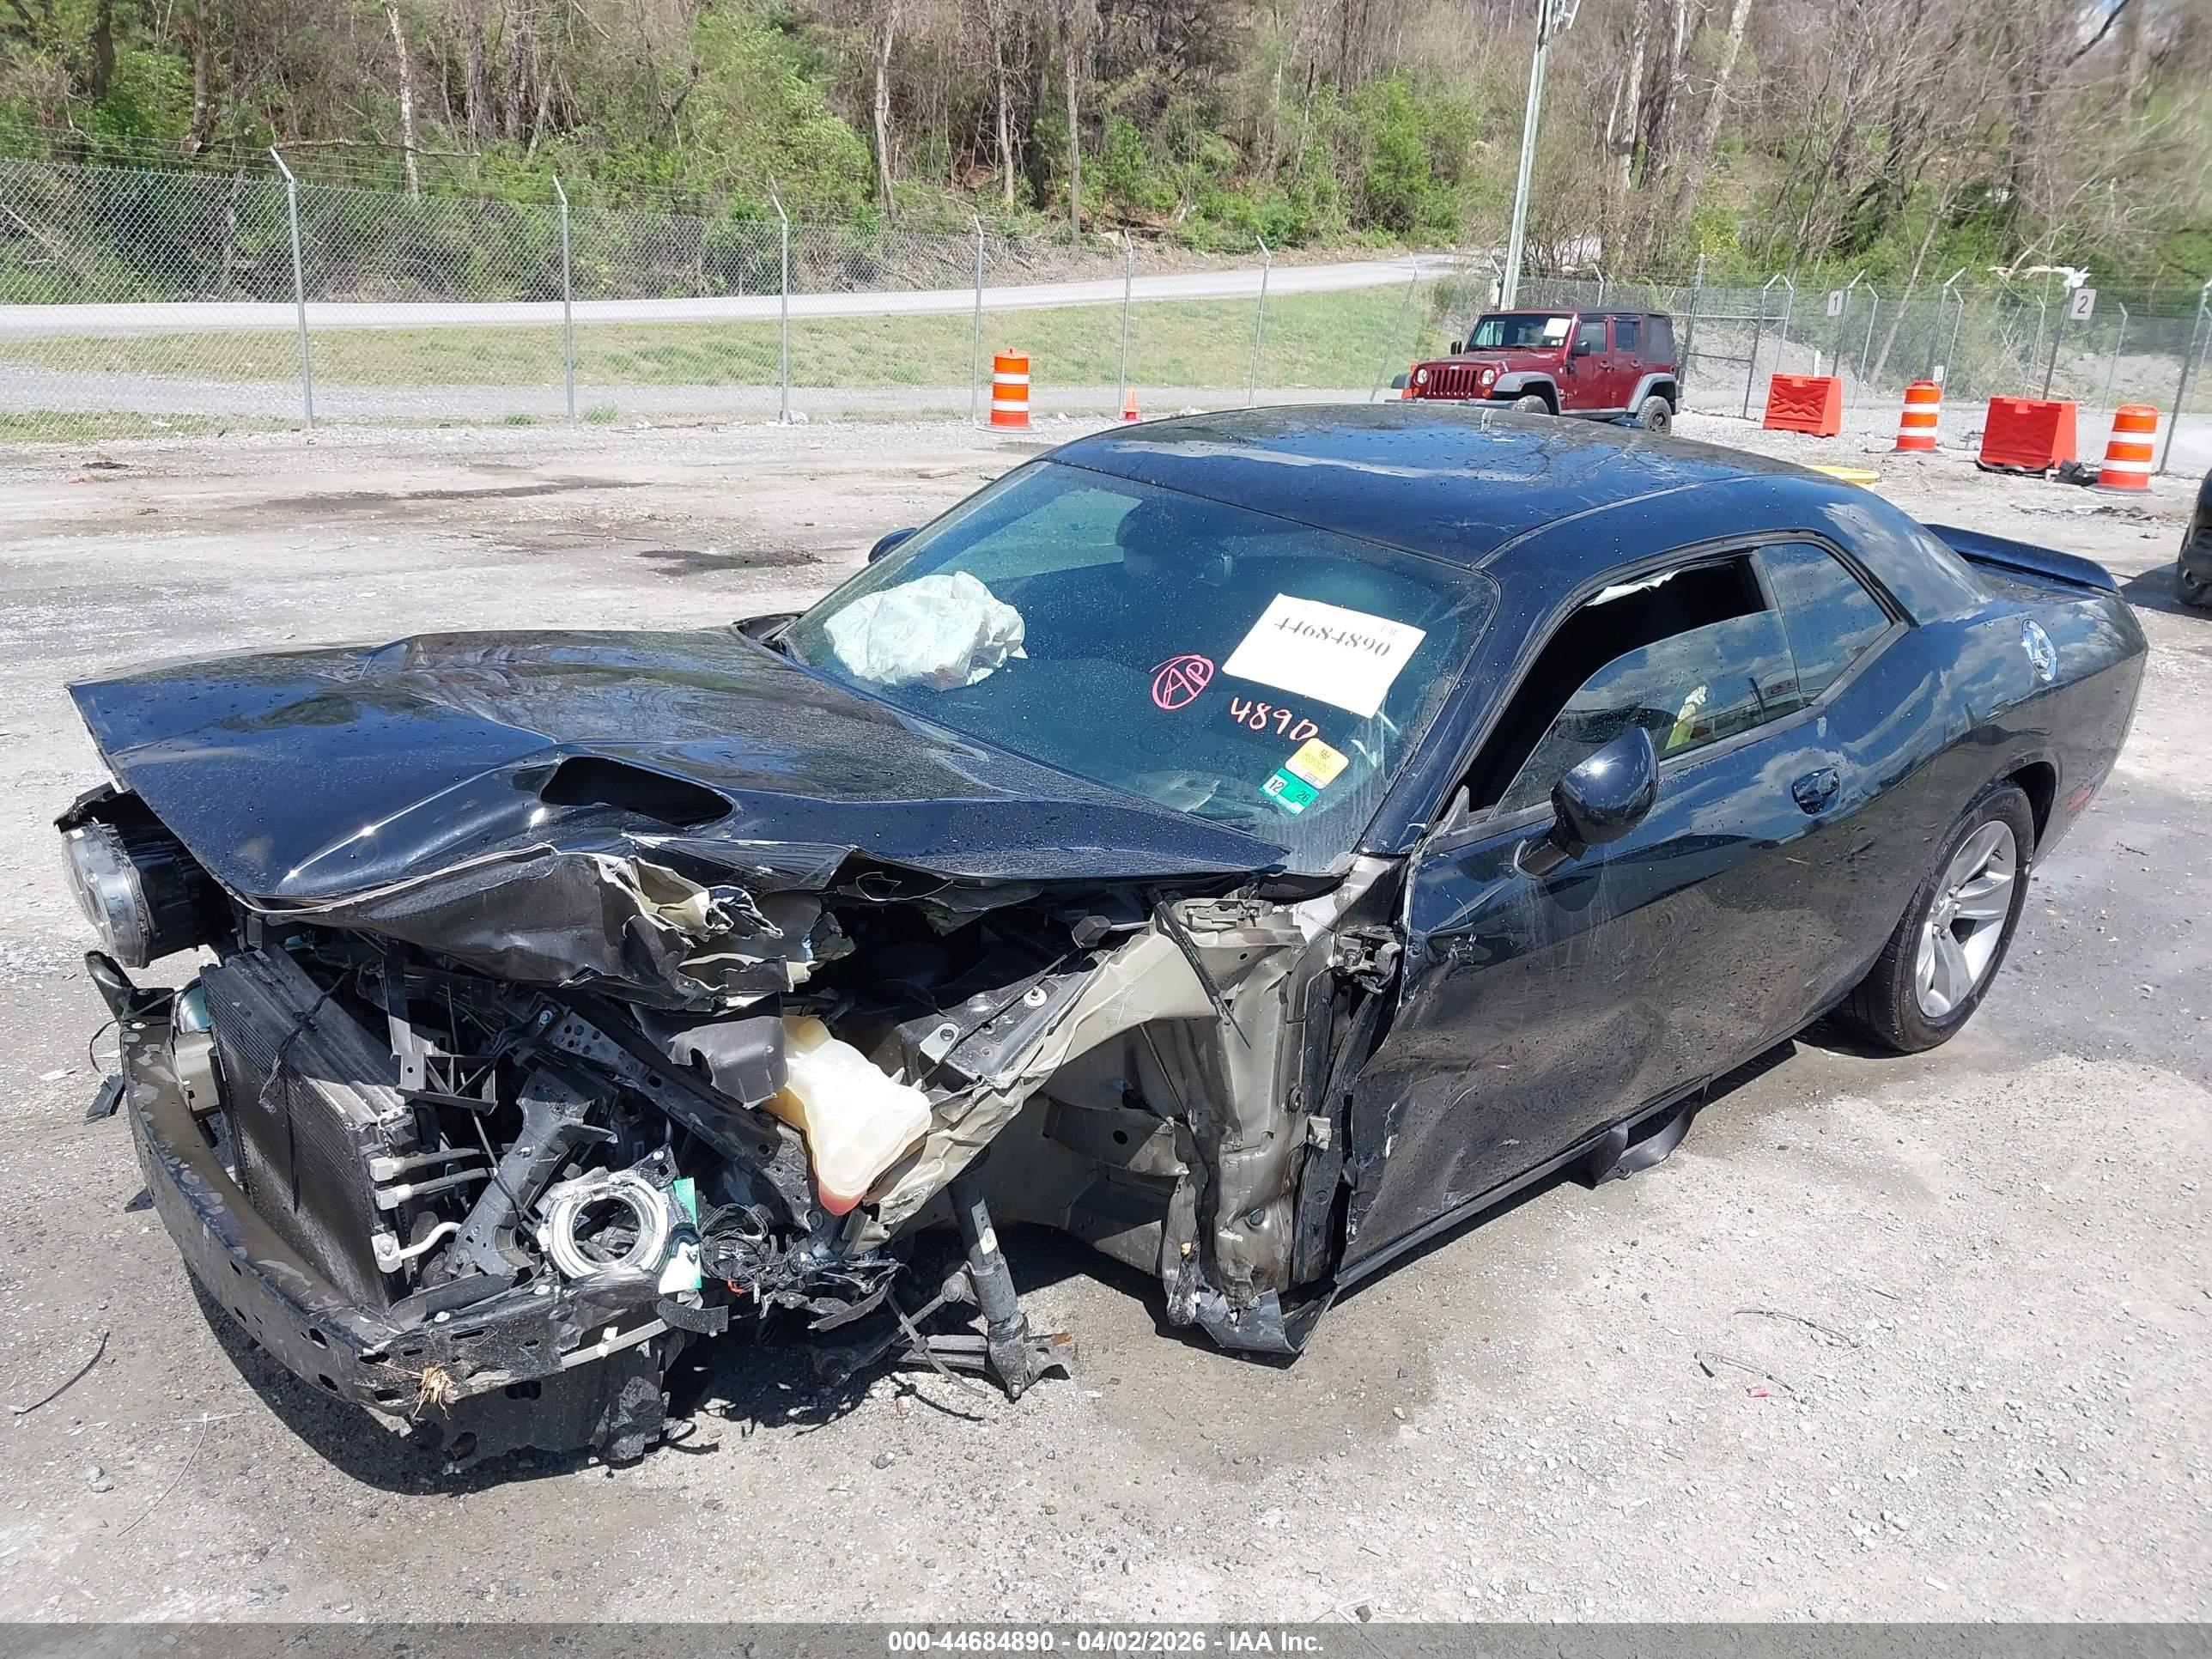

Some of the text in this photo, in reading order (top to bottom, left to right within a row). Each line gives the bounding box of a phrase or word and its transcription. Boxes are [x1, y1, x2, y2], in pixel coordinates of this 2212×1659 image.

[1833, 295, 1839, 311] 1
[2076, 295, 2089, 314] 2
[1273, 617, 1391, 658] 44684890
[1231, 696, 1319, 741] 4890
[1268, 778, 1285, 793] 12
[1295, 789, 1312, 804] 26
